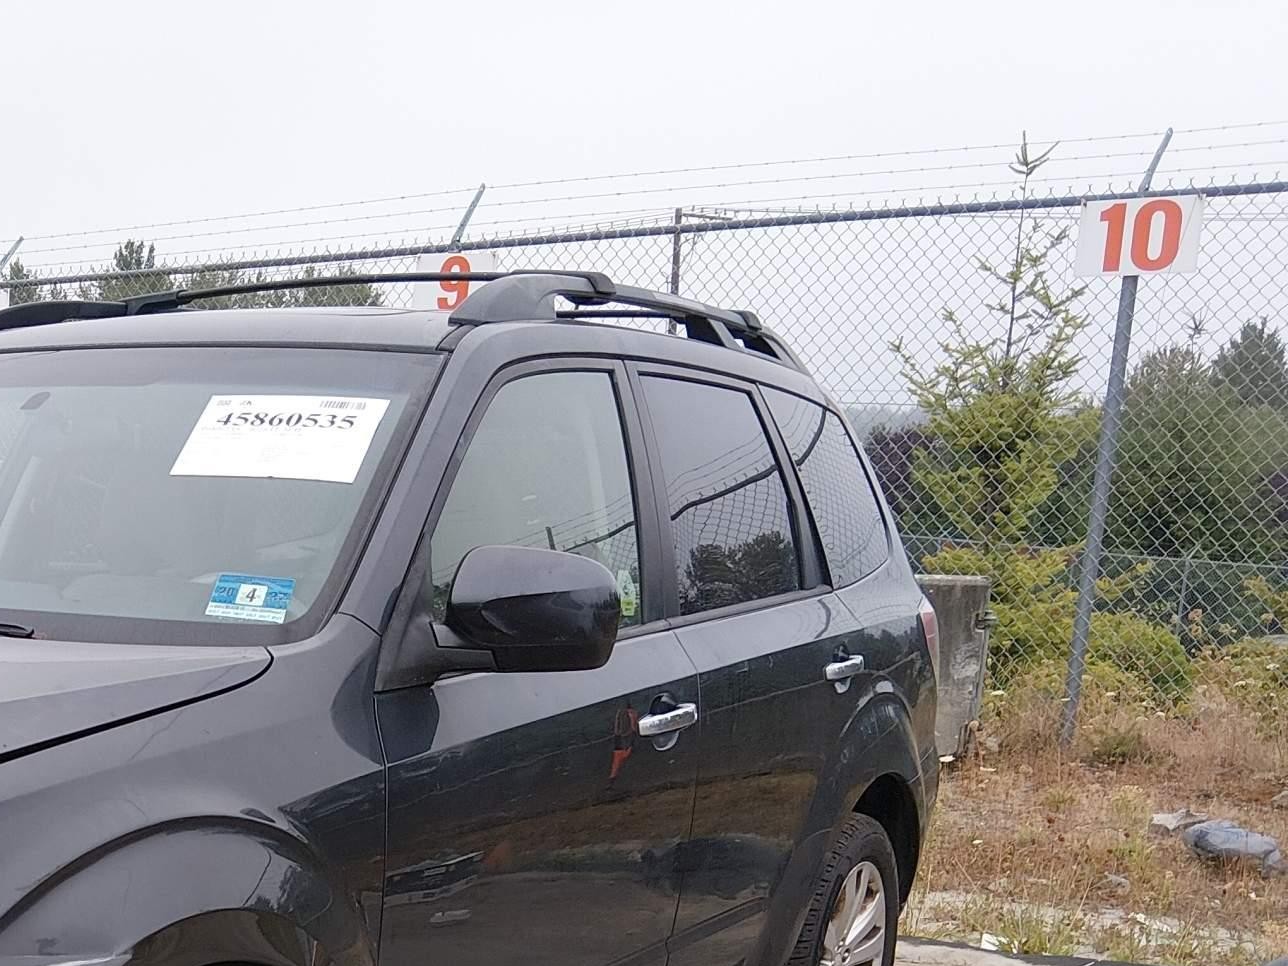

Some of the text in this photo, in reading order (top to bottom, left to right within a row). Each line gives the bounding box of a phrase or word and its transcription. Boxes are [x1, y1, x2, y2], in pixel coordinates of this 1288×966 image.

[1100, 199, 1183, 272] 10
[437, 255, 471, 310] 9
[215, 411, 358, 430] 45860535
[245, 587, 258, 603] 4
